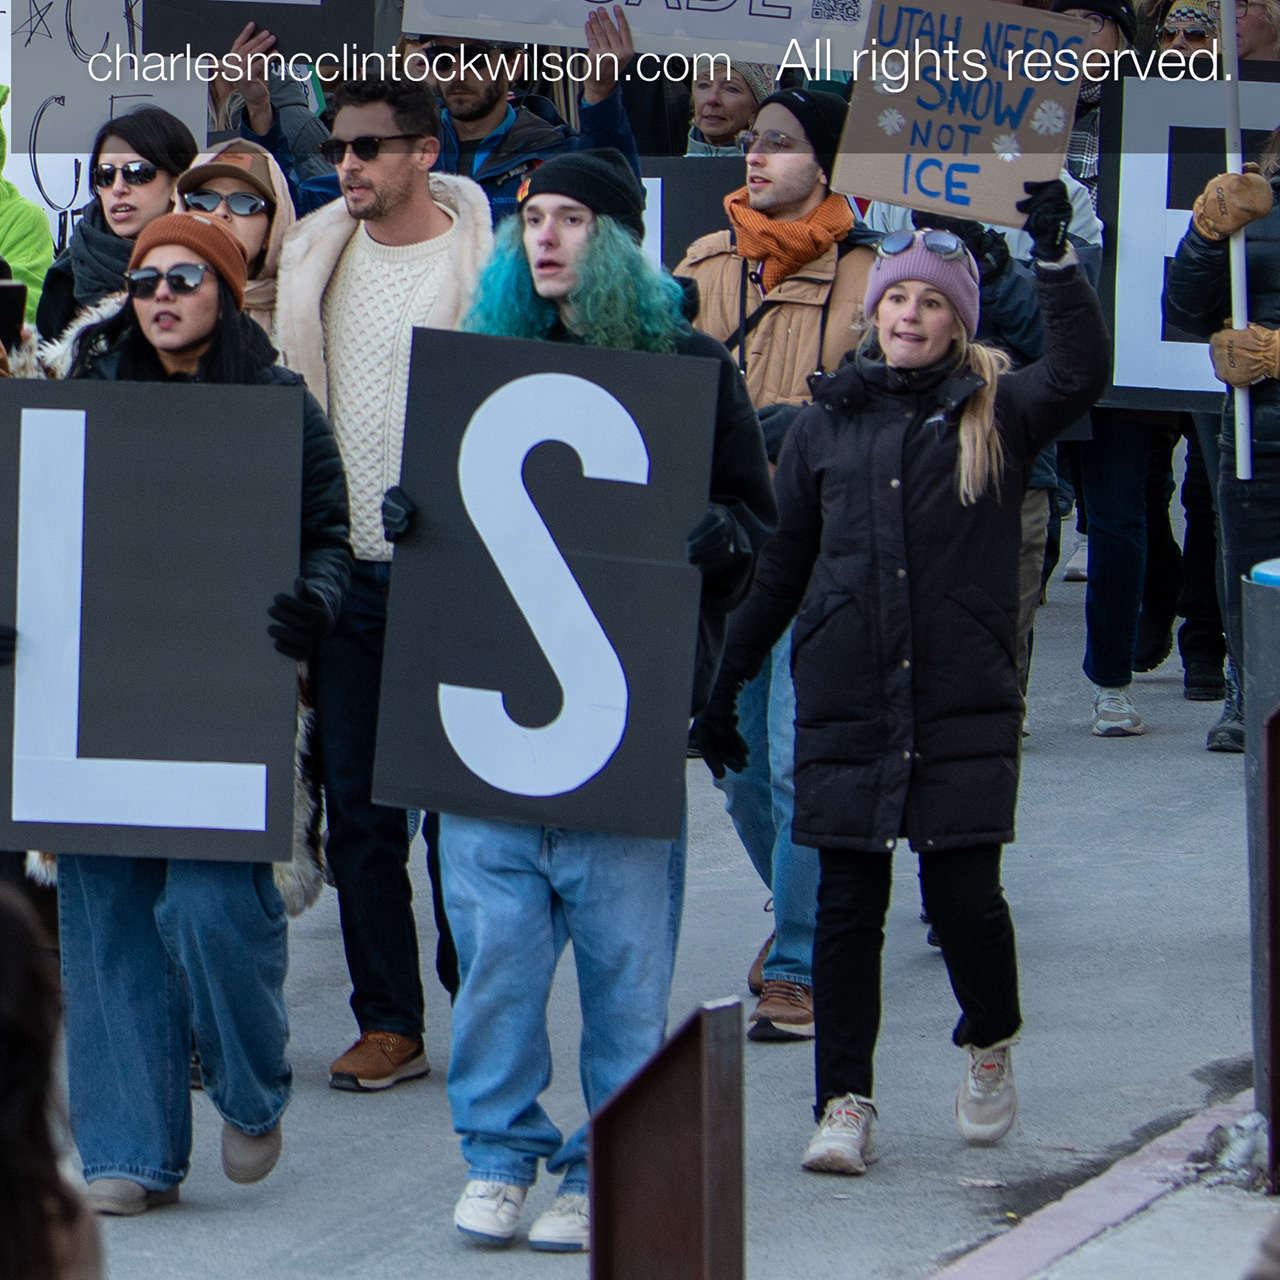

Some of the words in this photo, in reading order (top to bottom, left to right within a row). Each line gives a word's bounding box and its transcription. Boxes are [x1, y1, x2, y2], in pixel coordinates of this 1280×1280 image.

[878, 4, 962, 61] UTAH
[983, 21, 1083, 86] NEEDS
[916, 65, 1035, 130] SNOW
[910, 119, 982, 156] NOT
[903, 153, 980, 206] ICE
